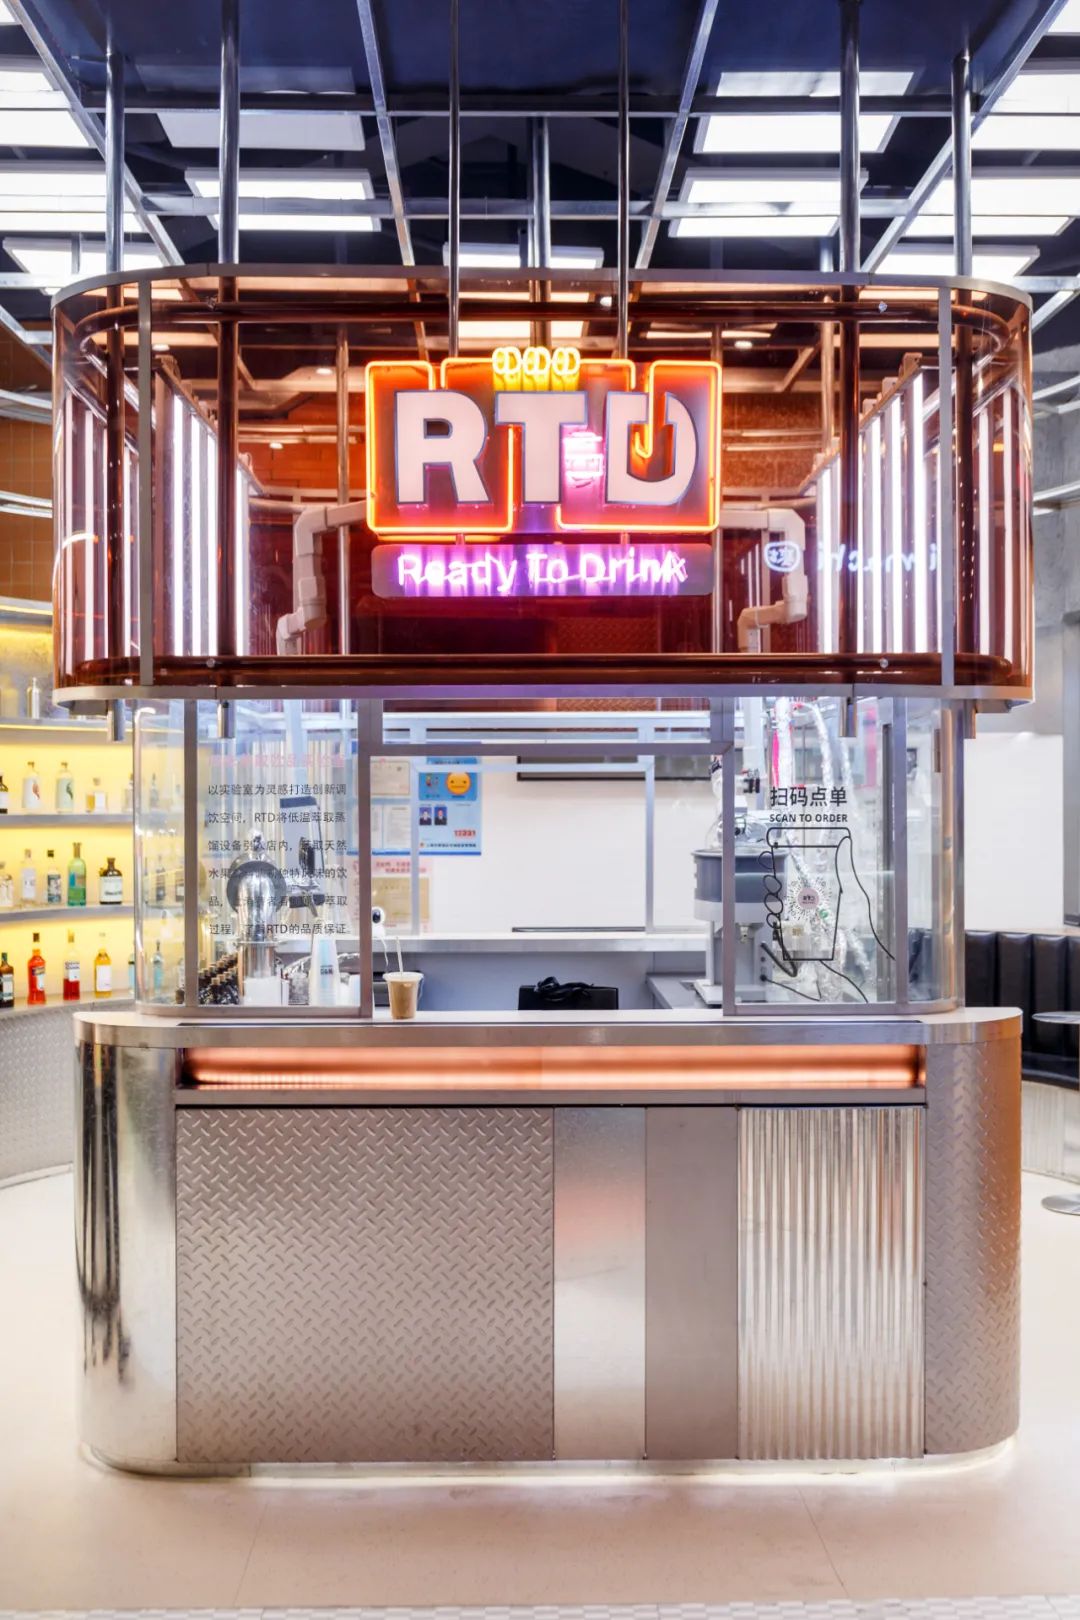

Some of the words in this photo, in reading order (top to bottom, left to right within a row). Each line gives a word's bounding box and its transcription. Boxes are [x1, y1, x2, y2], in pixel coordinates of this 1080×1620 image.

[394, 389, 699, 505] RTD
[397, 552, 518, 594] Ready
[526, 552, 569, 585] To
[579, 546, 689, 585] Drink
[207, 783, 347, 796] 以实验室为灵感打造创新调
[769, 786, 848, 807] 扫码点单
[769, 813, 797, 823] SCAN
[799, 813, 813, 823] TO
[814, 813, 848, 823] ORDER
